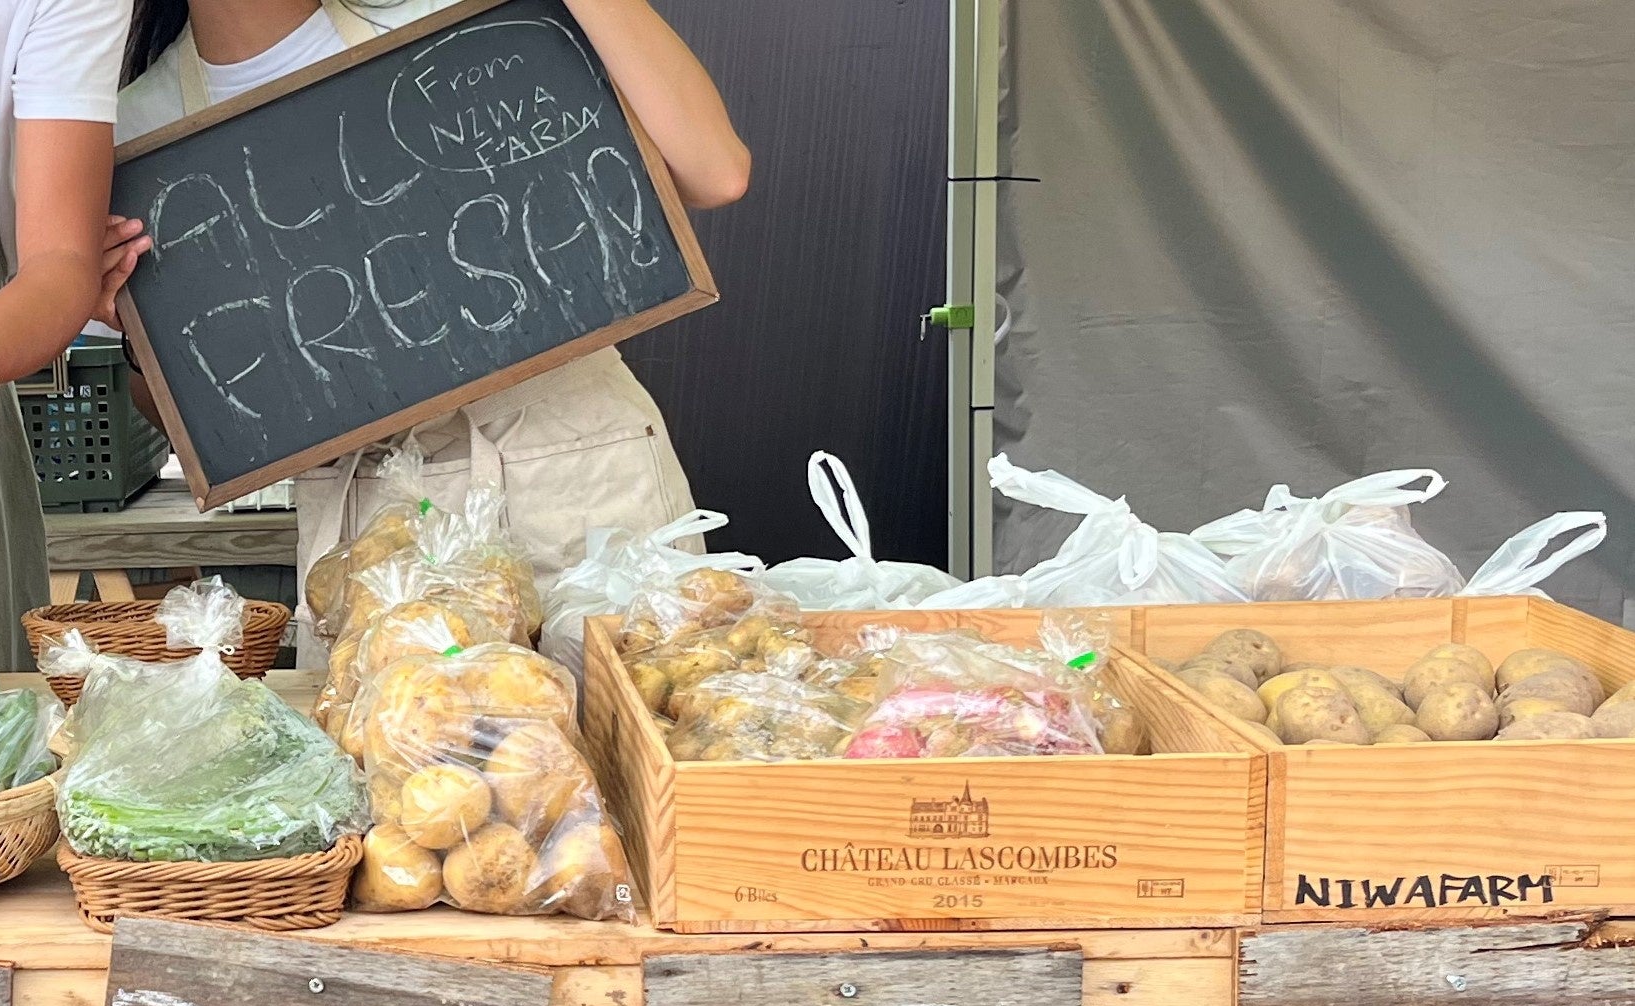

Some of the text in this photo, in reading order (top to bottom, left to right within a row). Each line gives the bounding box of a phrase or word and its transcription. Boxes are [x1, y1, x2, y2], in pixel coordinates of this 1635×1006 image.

[414, 54, 524, 104] From
[429, 86, 557, 156] NIWA
[149, 111, 422, 270] ALL
[801, 842, 1118, 872] CHÂTEAU LASCOMBES
[735, 886, 744, 903] 6
[933, 894, 984, 909] 2015
[1294, 873, 1554, 909] NIWAFARM
